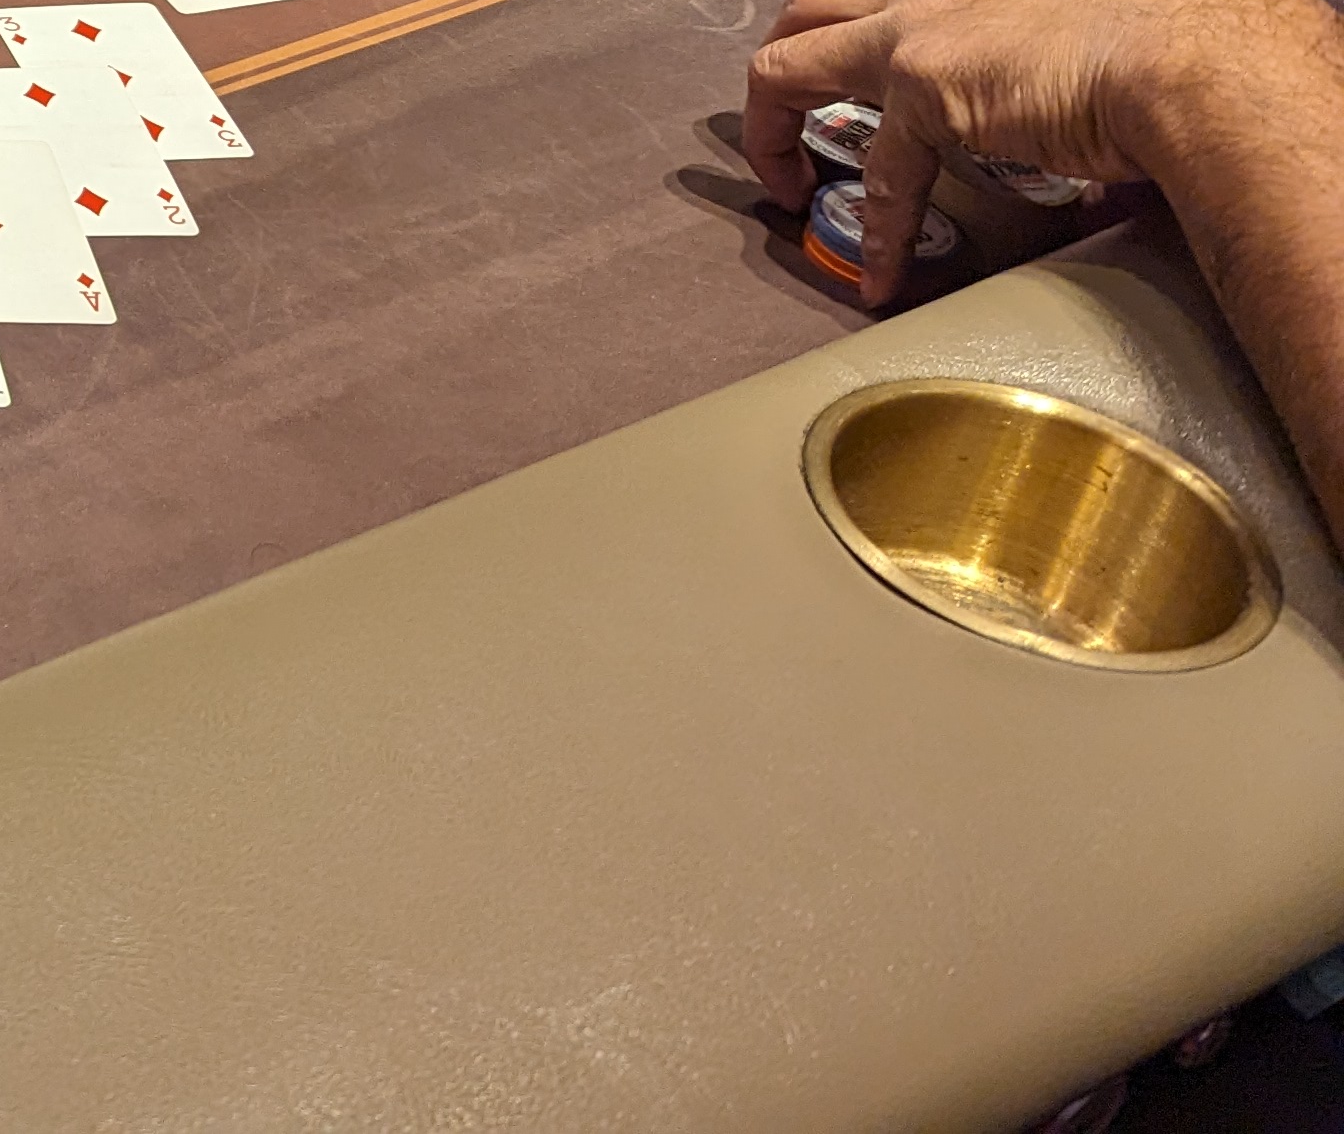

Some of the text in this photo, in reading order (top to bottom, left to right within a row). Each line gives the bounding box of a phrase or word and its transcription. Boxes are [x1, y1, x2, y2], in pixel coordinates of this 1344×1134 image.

[217, 130, 242, 148] 3
[162, 204, 186, 225] 2
[79, 290, 102, 312] A
